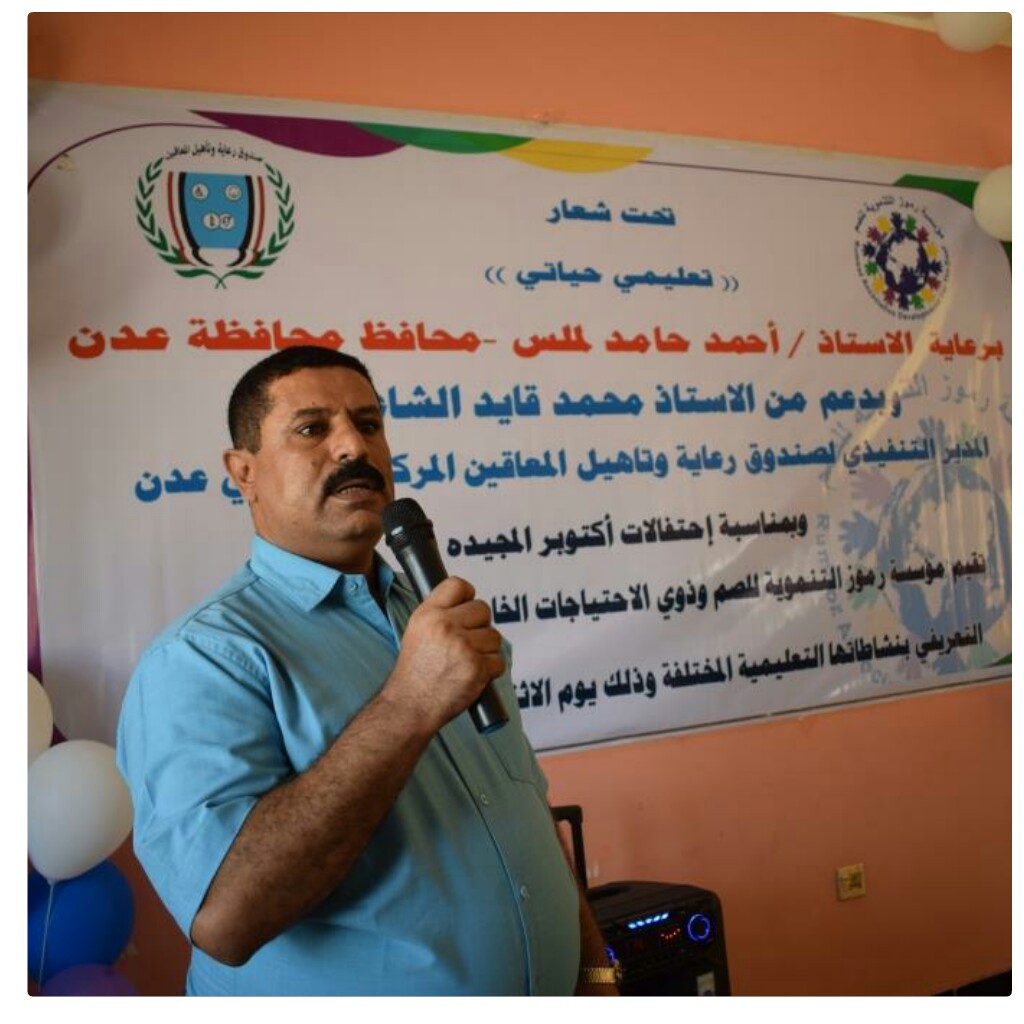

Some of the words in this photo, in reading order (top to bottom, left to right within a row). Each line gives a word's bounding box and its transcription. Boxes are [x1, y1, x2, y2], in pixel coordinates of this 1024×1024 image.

[546, 198, 611, 225] شعار
[620, 206, 676, 227] تحت
[516, 261, 602, 290] حياتي
[614, 266, 714, 294] تعليمي
[68, 324, 170, 358] عدن
[187, 318, 344, 351] محافظة
[513, 325, 592, 357] لملس
[605, 326, 690, 354] حامد
[704, 322, 780, 354] أحمد
[819, 329, 913, 355] الاستاذ
[929, 329, 1004, 362] برعاية
[474, 384, 541, 424] قايد
[553, 386, 644, 416] محمد
[655, 382, 755, 415] الاستاذ
[764, 389, 807, 419] من
[820, 388, 902, 420] وبدعم
[578, 445, 669, 480] وتاهيل
[676, 446, 737, 475] رعاية
[746, 439, 836, 474] لصندوق
[843, 438, 936, 474] التنفيذي
[943, 436, 990, 464] المدير
[134, 466, 208, 503] عدن
[391, 452, 456, 489] المرك
[464, 450, 567, 489] المعاقين
[538, 513, 615, 558] أكتوبر
[620, 514, 713, 547] إحتفالات
[719, 510, 808, 539] وبمناسبة
[447, 525, 532, 562] المجيده
[765, 565, 842, 603] التنموية
[847, 565, 886, 594] رموز
[890, 557, 945, 586] مؤسسة
[491, 593, 528, 624] الخا
[535, 583, 650, 623] الاحتياجات
[659, 584, 708, 621] وذوي
[713, 576, 760, 612] للصم
[829, 633, 910, 666] بنشاطاتها
[916, 623, 984, 665] التعريفي
[604, 660, 657, 699] وذلك
[662, 657, 733, 691] المختلفة
[738, 644, 825, 684] التعليمية
[558, 679, 597, 714] يوم
